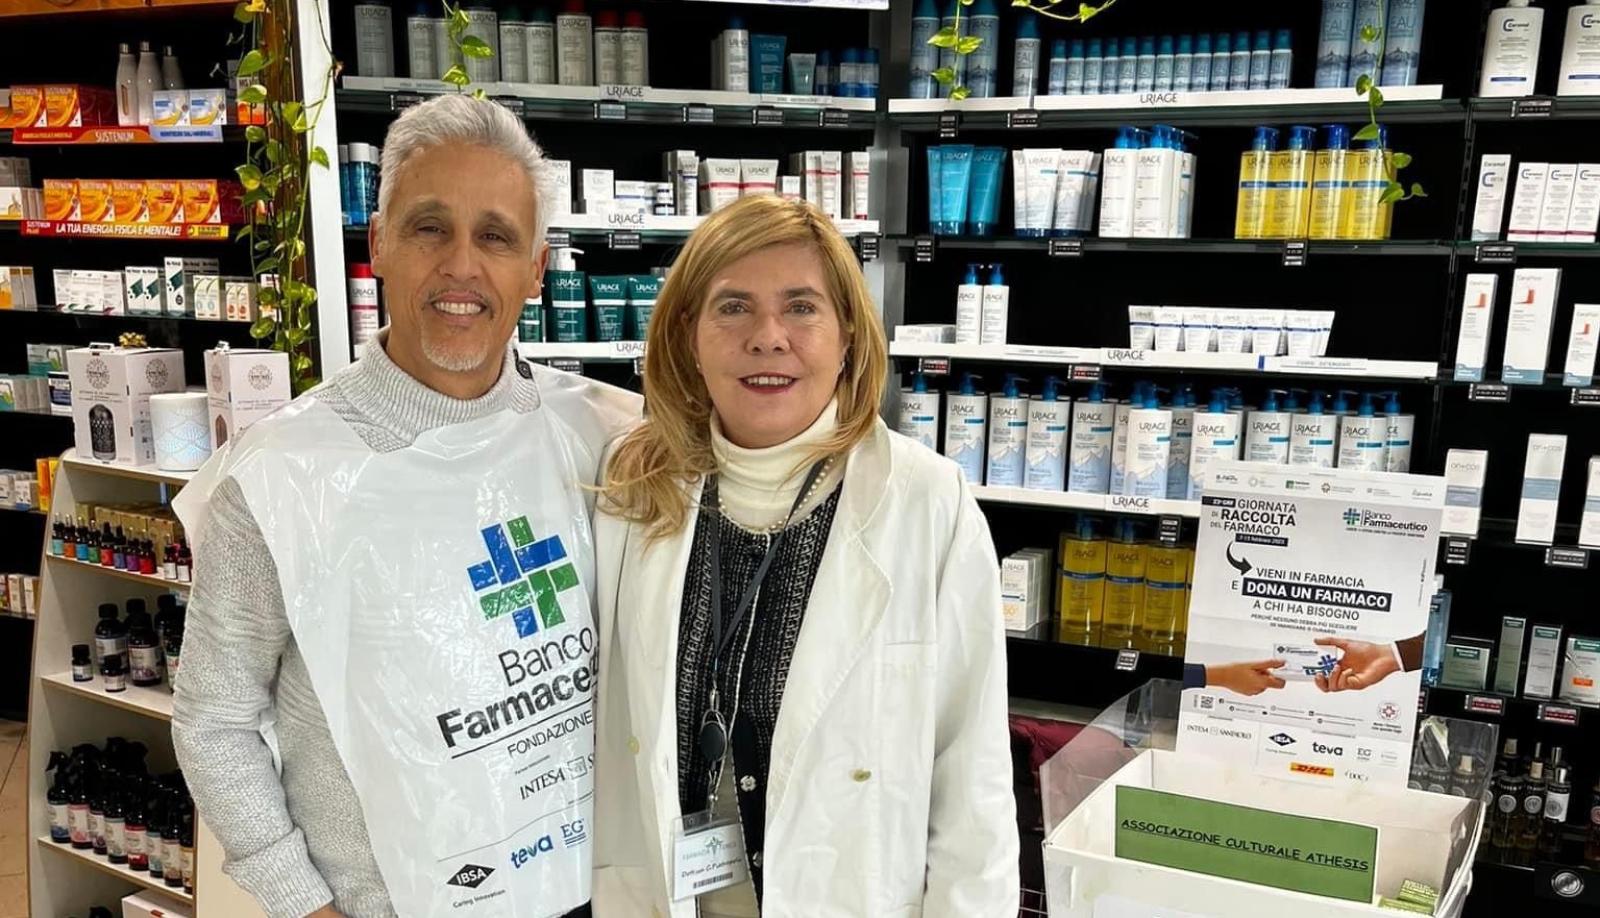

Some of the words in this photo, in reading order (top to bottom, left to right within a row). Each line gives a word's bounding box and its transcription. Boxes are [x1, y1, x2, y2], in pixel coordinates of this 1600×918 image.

[1391, 16, 1416, 29] EAU
[607, 86, 645, 98] URIAGE
[1140, 93, 1177, 105] URIAGE
[95, 130, 134, 143] SUSTENIUM
[716, 166, 736, 174] URIAGE
[749, 166, 770, 174] URIAGE
[608, 213, 645, 226] URIAGE
[56, 224, 66, 233] LA
[67, 224, 81, 233] TUA
[83, 224, 113, 234] ENERGIA
[115, 225, 138, 234] FISICA
[138, 225, 143, 234] E
[556, 278, 582, 289] URIAGE
[597, 283, 619, 291] URIAGE
[635, 283, 657, 291] URIAGE
[1107, 350, 1145, 362] URIAGE
[950, 404, 975, 415] URIAGE
[993, 407, 1018, 417] URIAGE
[1032, 412, 1057, 422] URIAGE
[1076, 412, 1102, 422] URIAGE
[1139, 421, 1167, 432] URIAGE
[1197, 425, 1226, 435] URIAGE
[1252, 422, 1281, 432] URIAGE
[1294, 424, 1322, 435] URIAGE
[1344, 426, 1370, 436] URIAGE
[1112, 496, 1149, 508] URIAGE
[1237, 499, 1297, 514] GIORNATA
[1221, 509, 1296, 526] RACCOLTA
[1365, 510, 1391, 520] Banco
[1210, 521, 1221, 529] DEL
[1224, 521, 1281, 536] FARMACO
[1363, 518, 1428, 532] Farmaceutico
[1256, 567, 1286, 580] VIENI
[1289, 571, 1301, 581] IN
[1304, 573, 1365, 588] FARMACIA
[1231, 580, 1239, 590] E
[1246, 581, 1288, 597] DONA
[1290, 586, 1312, 600] UN
[1314, 588, 1388, 609] FARMACO
[1253, 599, 1260, 609] A
[1264, 600, 1283, 612] CHI
[1287, 604, 1304, 614] HA
[1307, 605, 1360, 621] BISOGNO
[1273, 616, 1298, 624] NESSUNO
[498, 627, 594, 687] Banco
[507, 710, 593, 757] FONDAZIONE
[1312, 741, 1344, 756] teva
[1357, 747, 1372, 757] EG
[520, 767, 566, 800] INTESA
[560, 820, 584, 838] EG
[1121, 819, 1221, 845] ASSOCIAZIONE
[1225, 837, 1301, 860] CULTURALE
[1305, 851, 1369, 871] ATHESIS
[510, 835, 554, 869] teva
[456, 860, 487, 885] IBSA
[453, 897, 474, 909] Caring
[474, 889, 506, 902] Innovation
